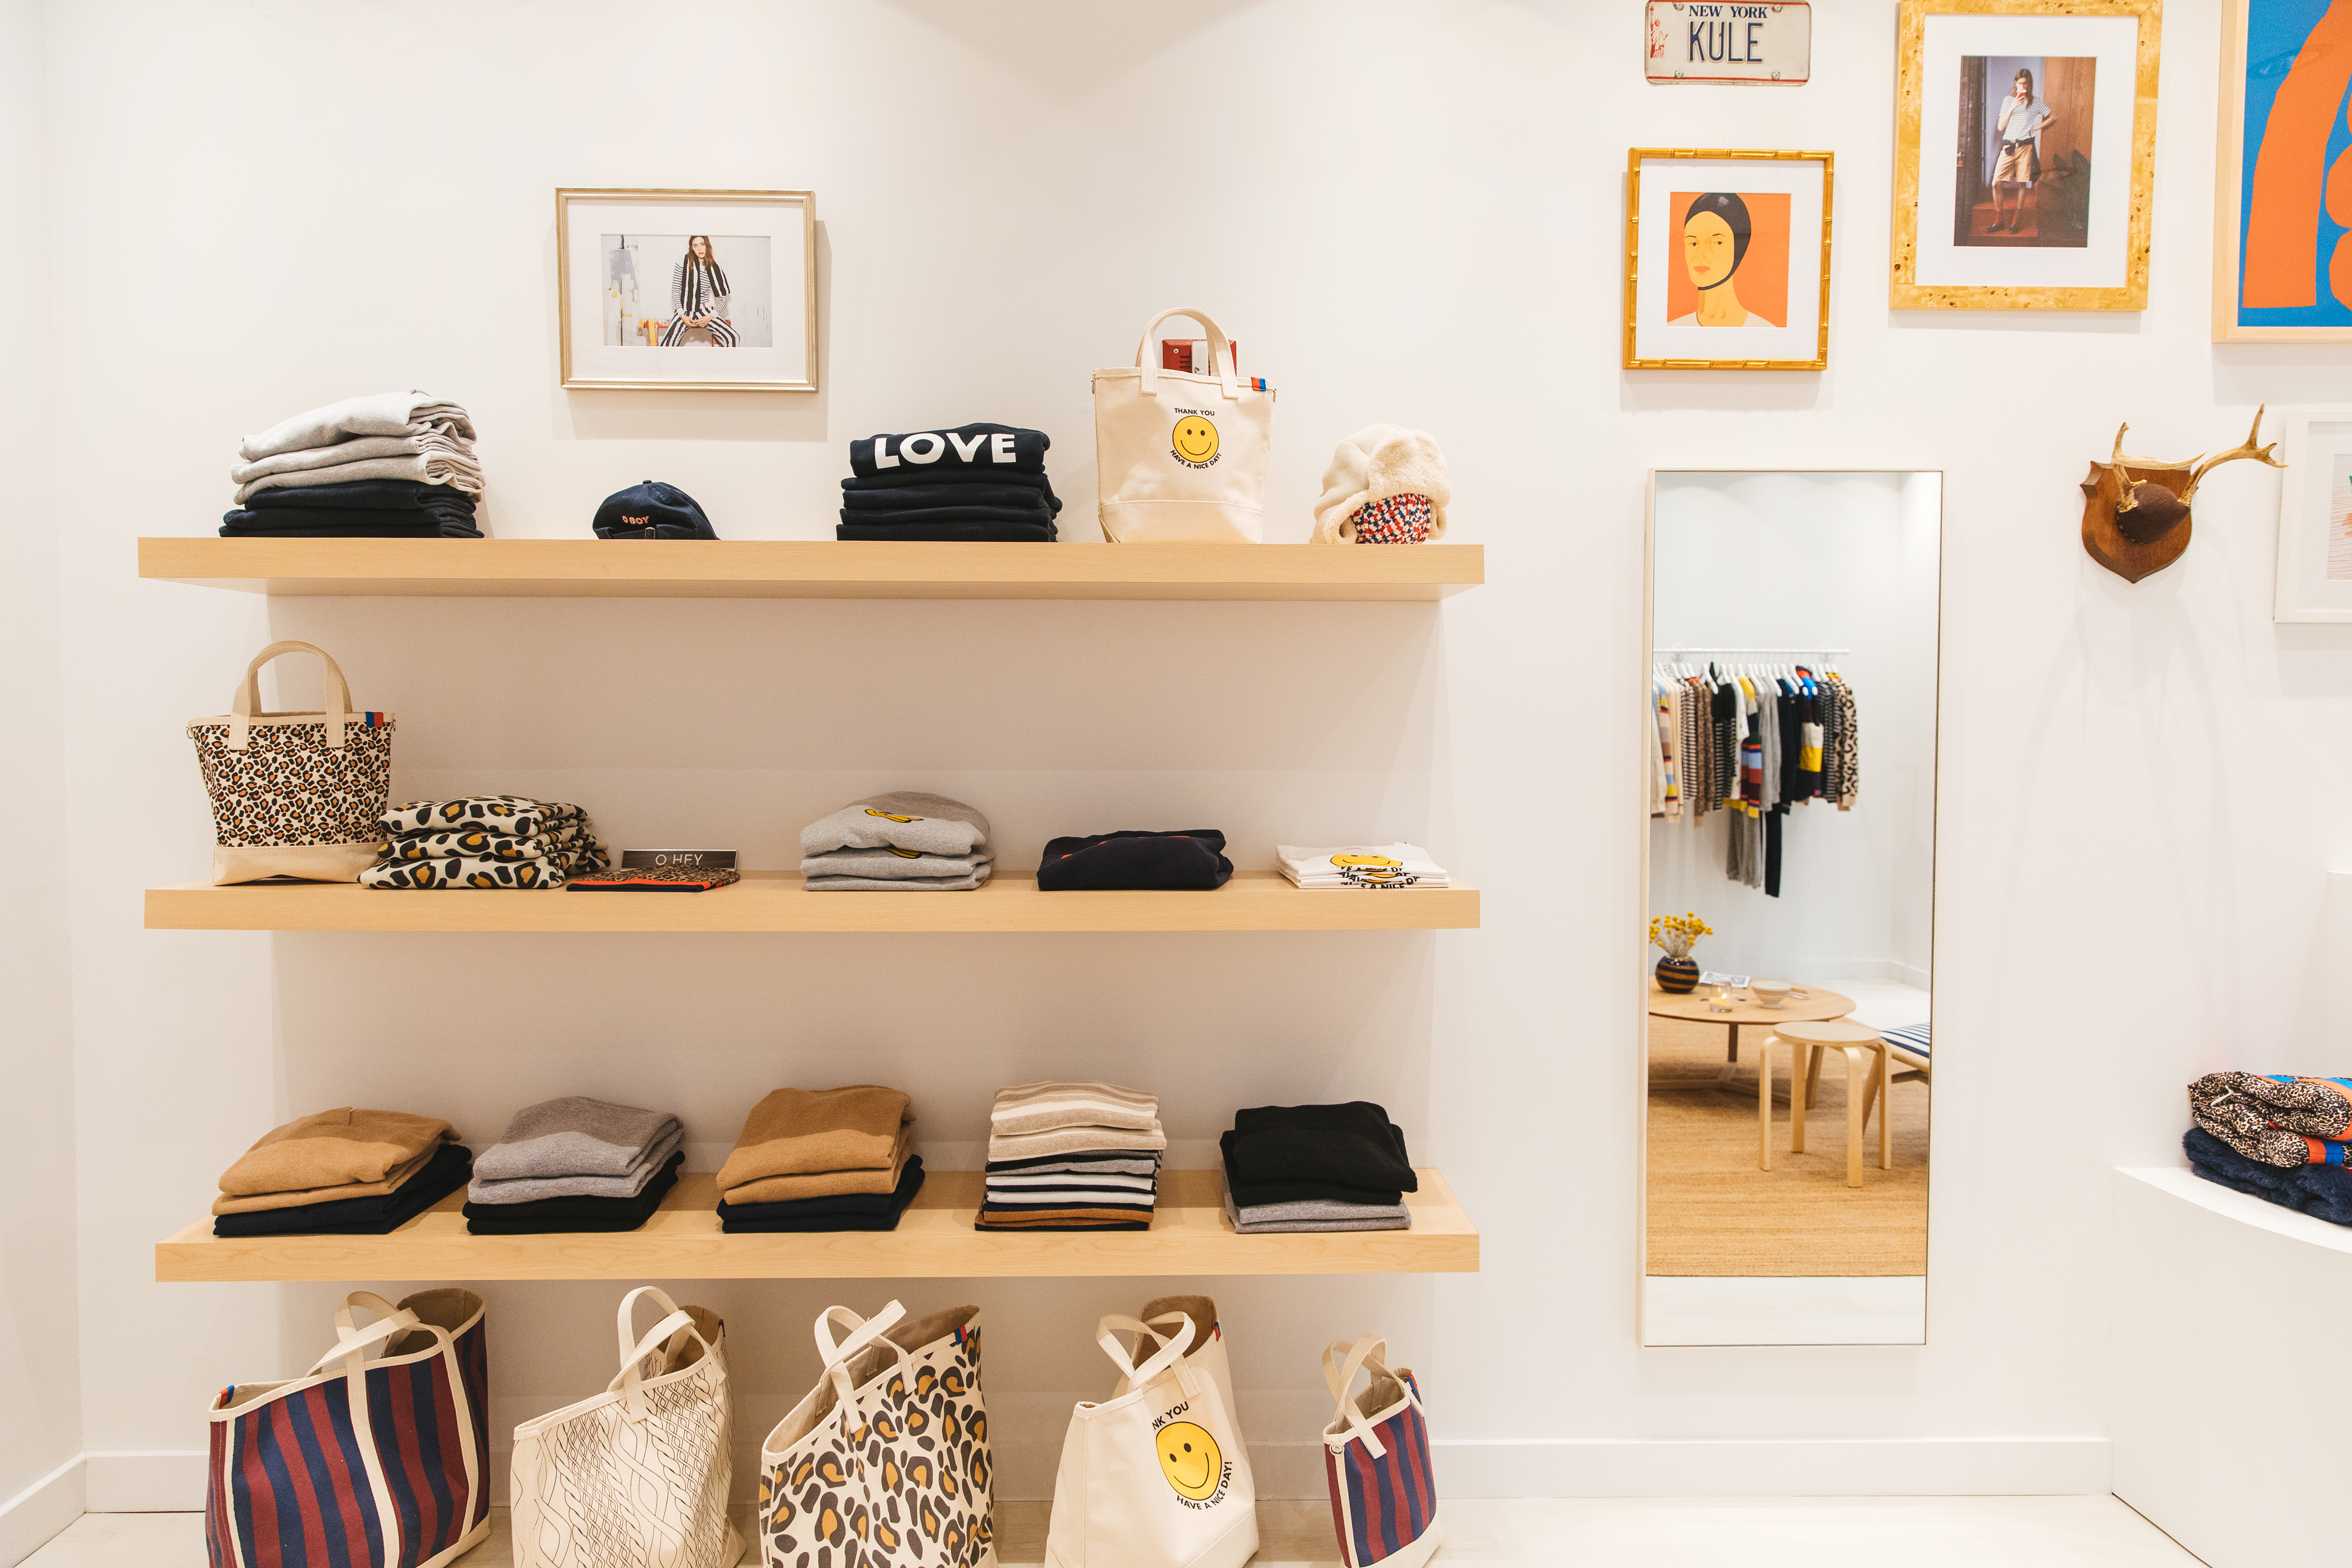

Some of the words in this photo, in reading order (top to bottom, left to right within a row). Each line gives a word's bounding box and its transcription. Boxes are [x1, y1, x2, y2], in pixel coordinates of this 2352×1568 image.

[1689, 5, 1723, 17] NEW
[1730, 6, 1768, 18] YORK
[1689, 21, 1764, 62] KULE
[874, 432, 1017, 469] LOVE
[1170, 449, 1186, 465] HAVE
[1209, 453, 1222, 466] DAY!
[655, 854, 667, 866] O
[1165, 1401, 1189, 1419] YOU
[1177, 1494, 1202, 1510] HAVE
[1210, 1489, 1226, 1506] NICE
[1220, 1461, 1232, 1489] DAY!
